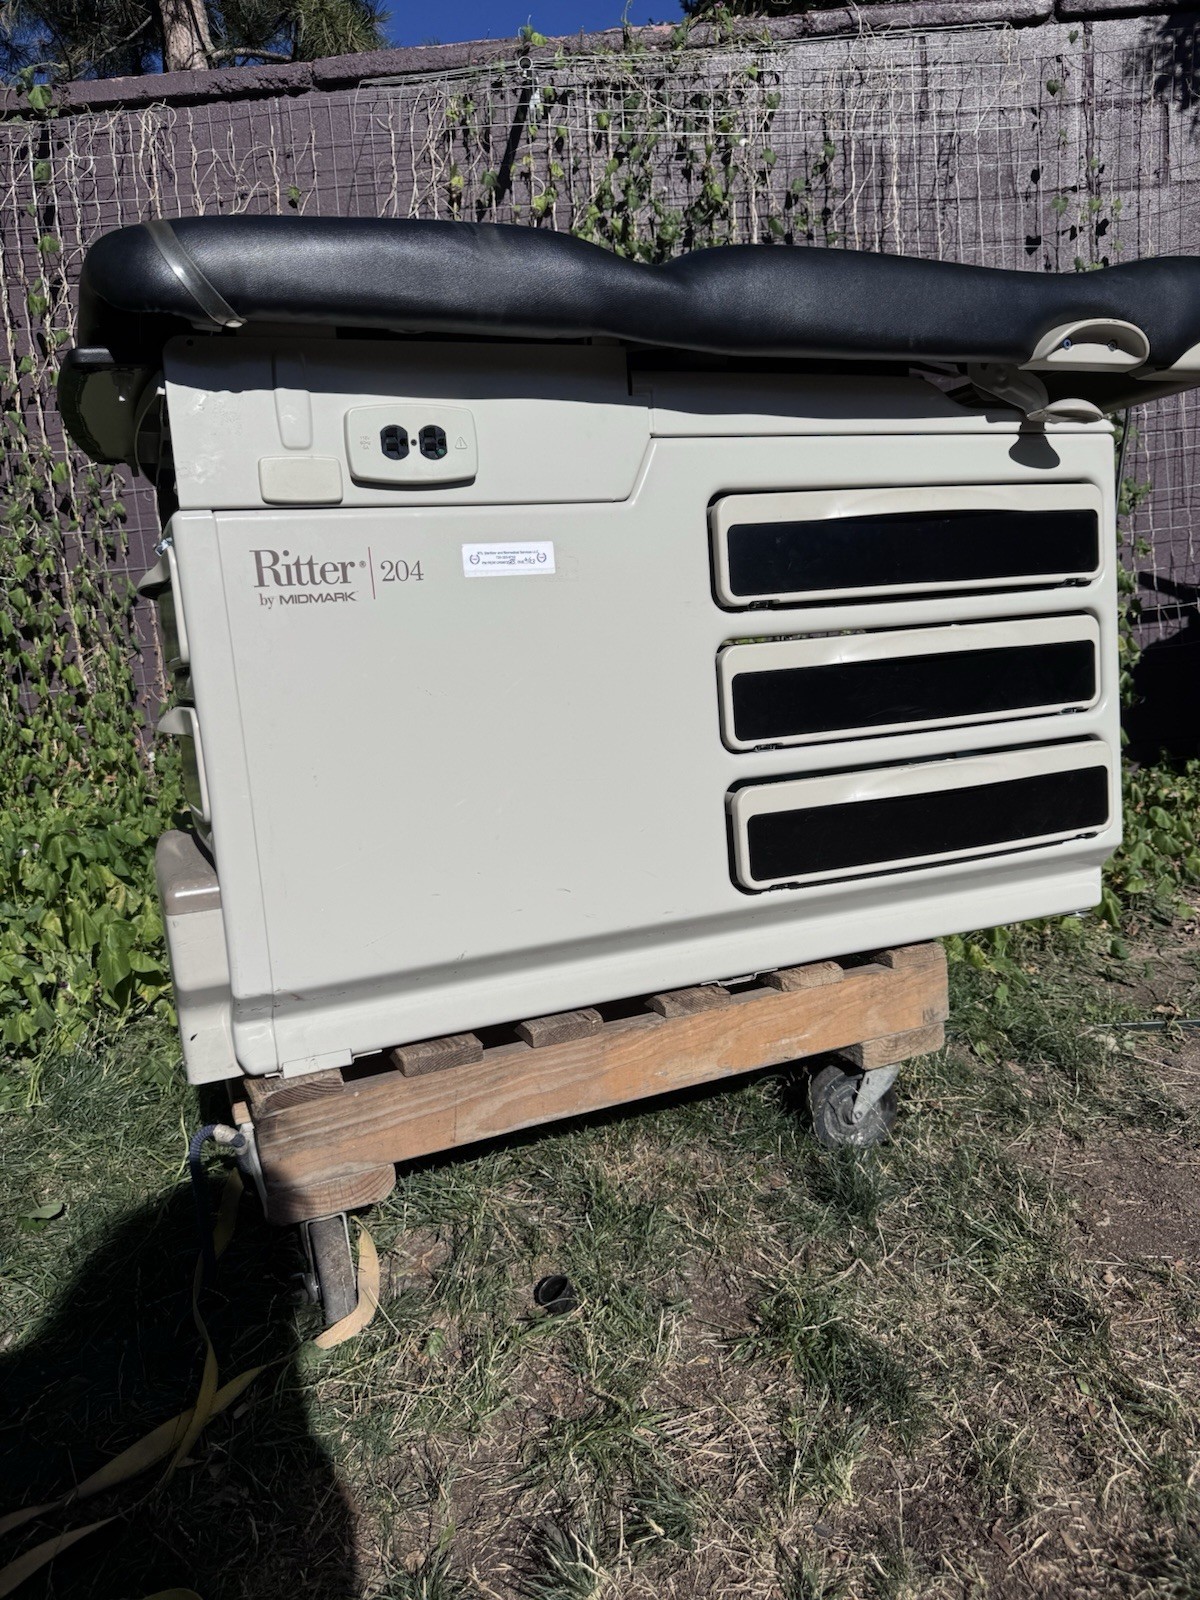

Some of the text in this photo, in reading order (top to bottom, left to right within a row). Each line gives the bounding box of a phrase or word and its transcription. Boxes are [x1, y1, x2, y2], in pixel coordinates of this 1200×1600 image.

[249, 550, 424, 588] Ritter 204
[259, 592, 357, 610] by MIDMARK
